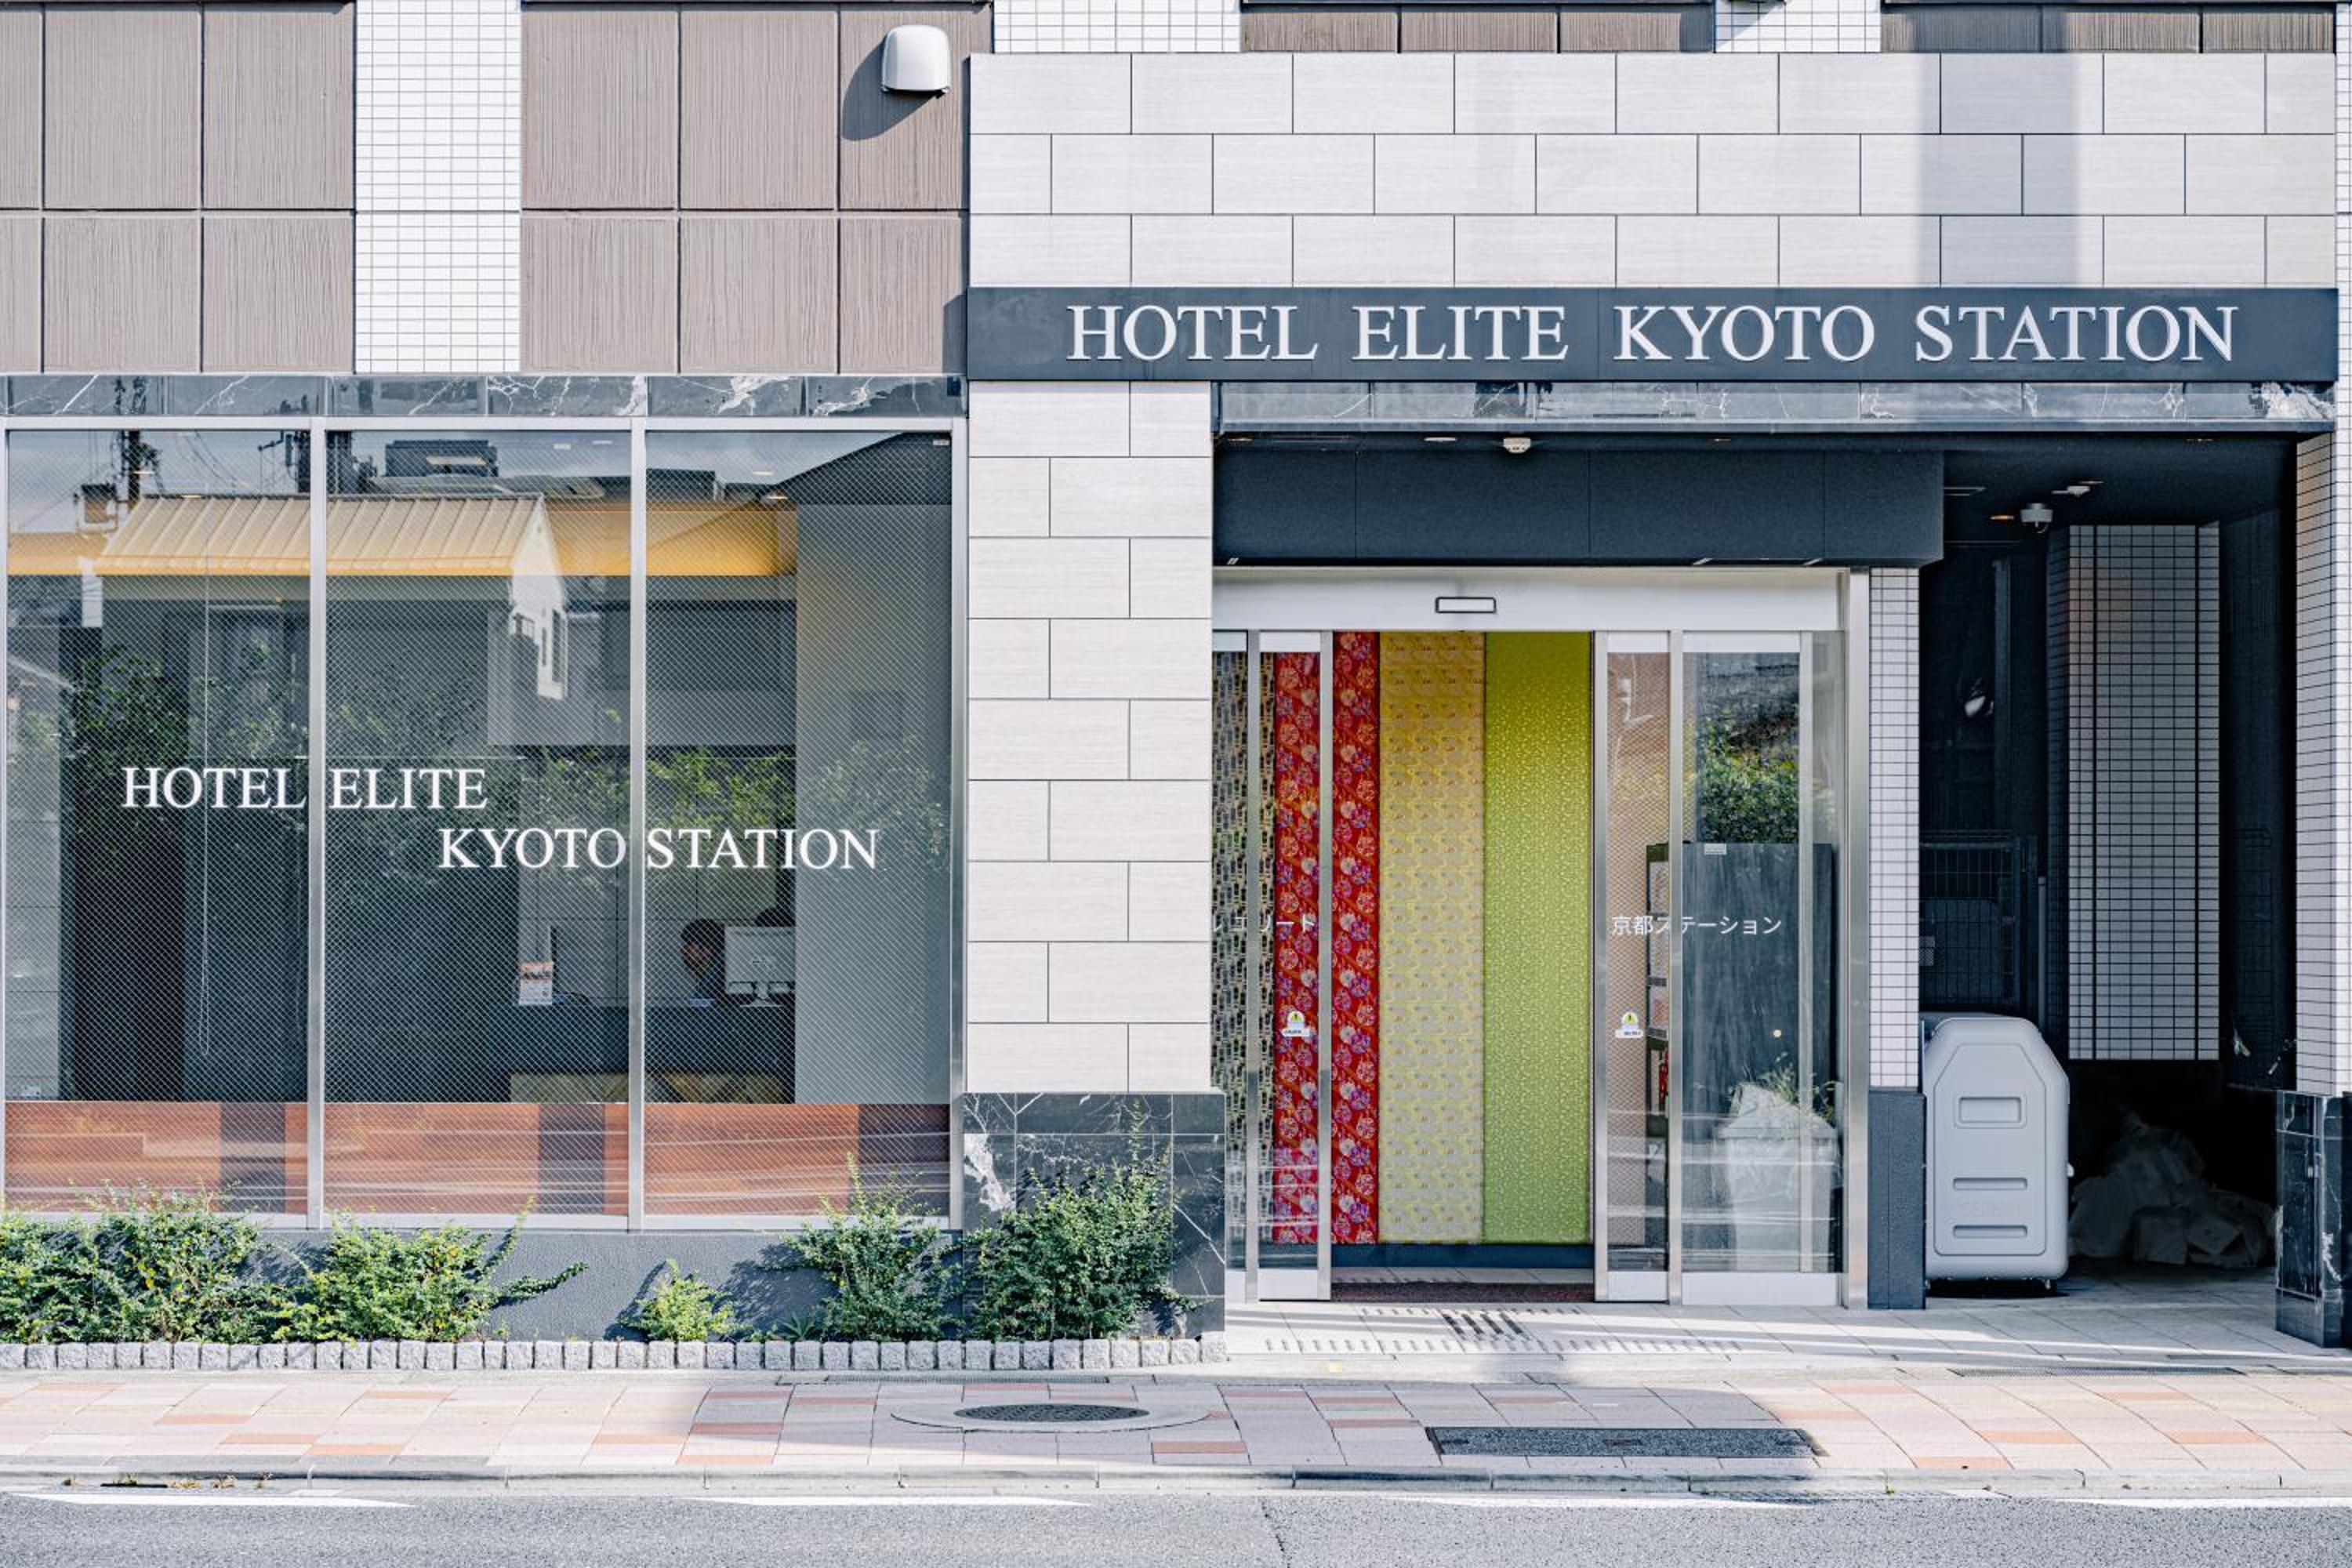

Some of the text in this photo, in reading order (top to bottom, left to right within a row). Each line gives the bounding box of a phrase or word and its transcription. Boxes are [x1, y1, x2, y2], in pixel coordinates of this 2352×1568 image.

[1067, 306, 2239, 363] HOTEL ELITE KYOTO STATION
[122, 767, 488, 810] HOTEL ELITE
[438, 828, 880, 869] KYOTO STATION
